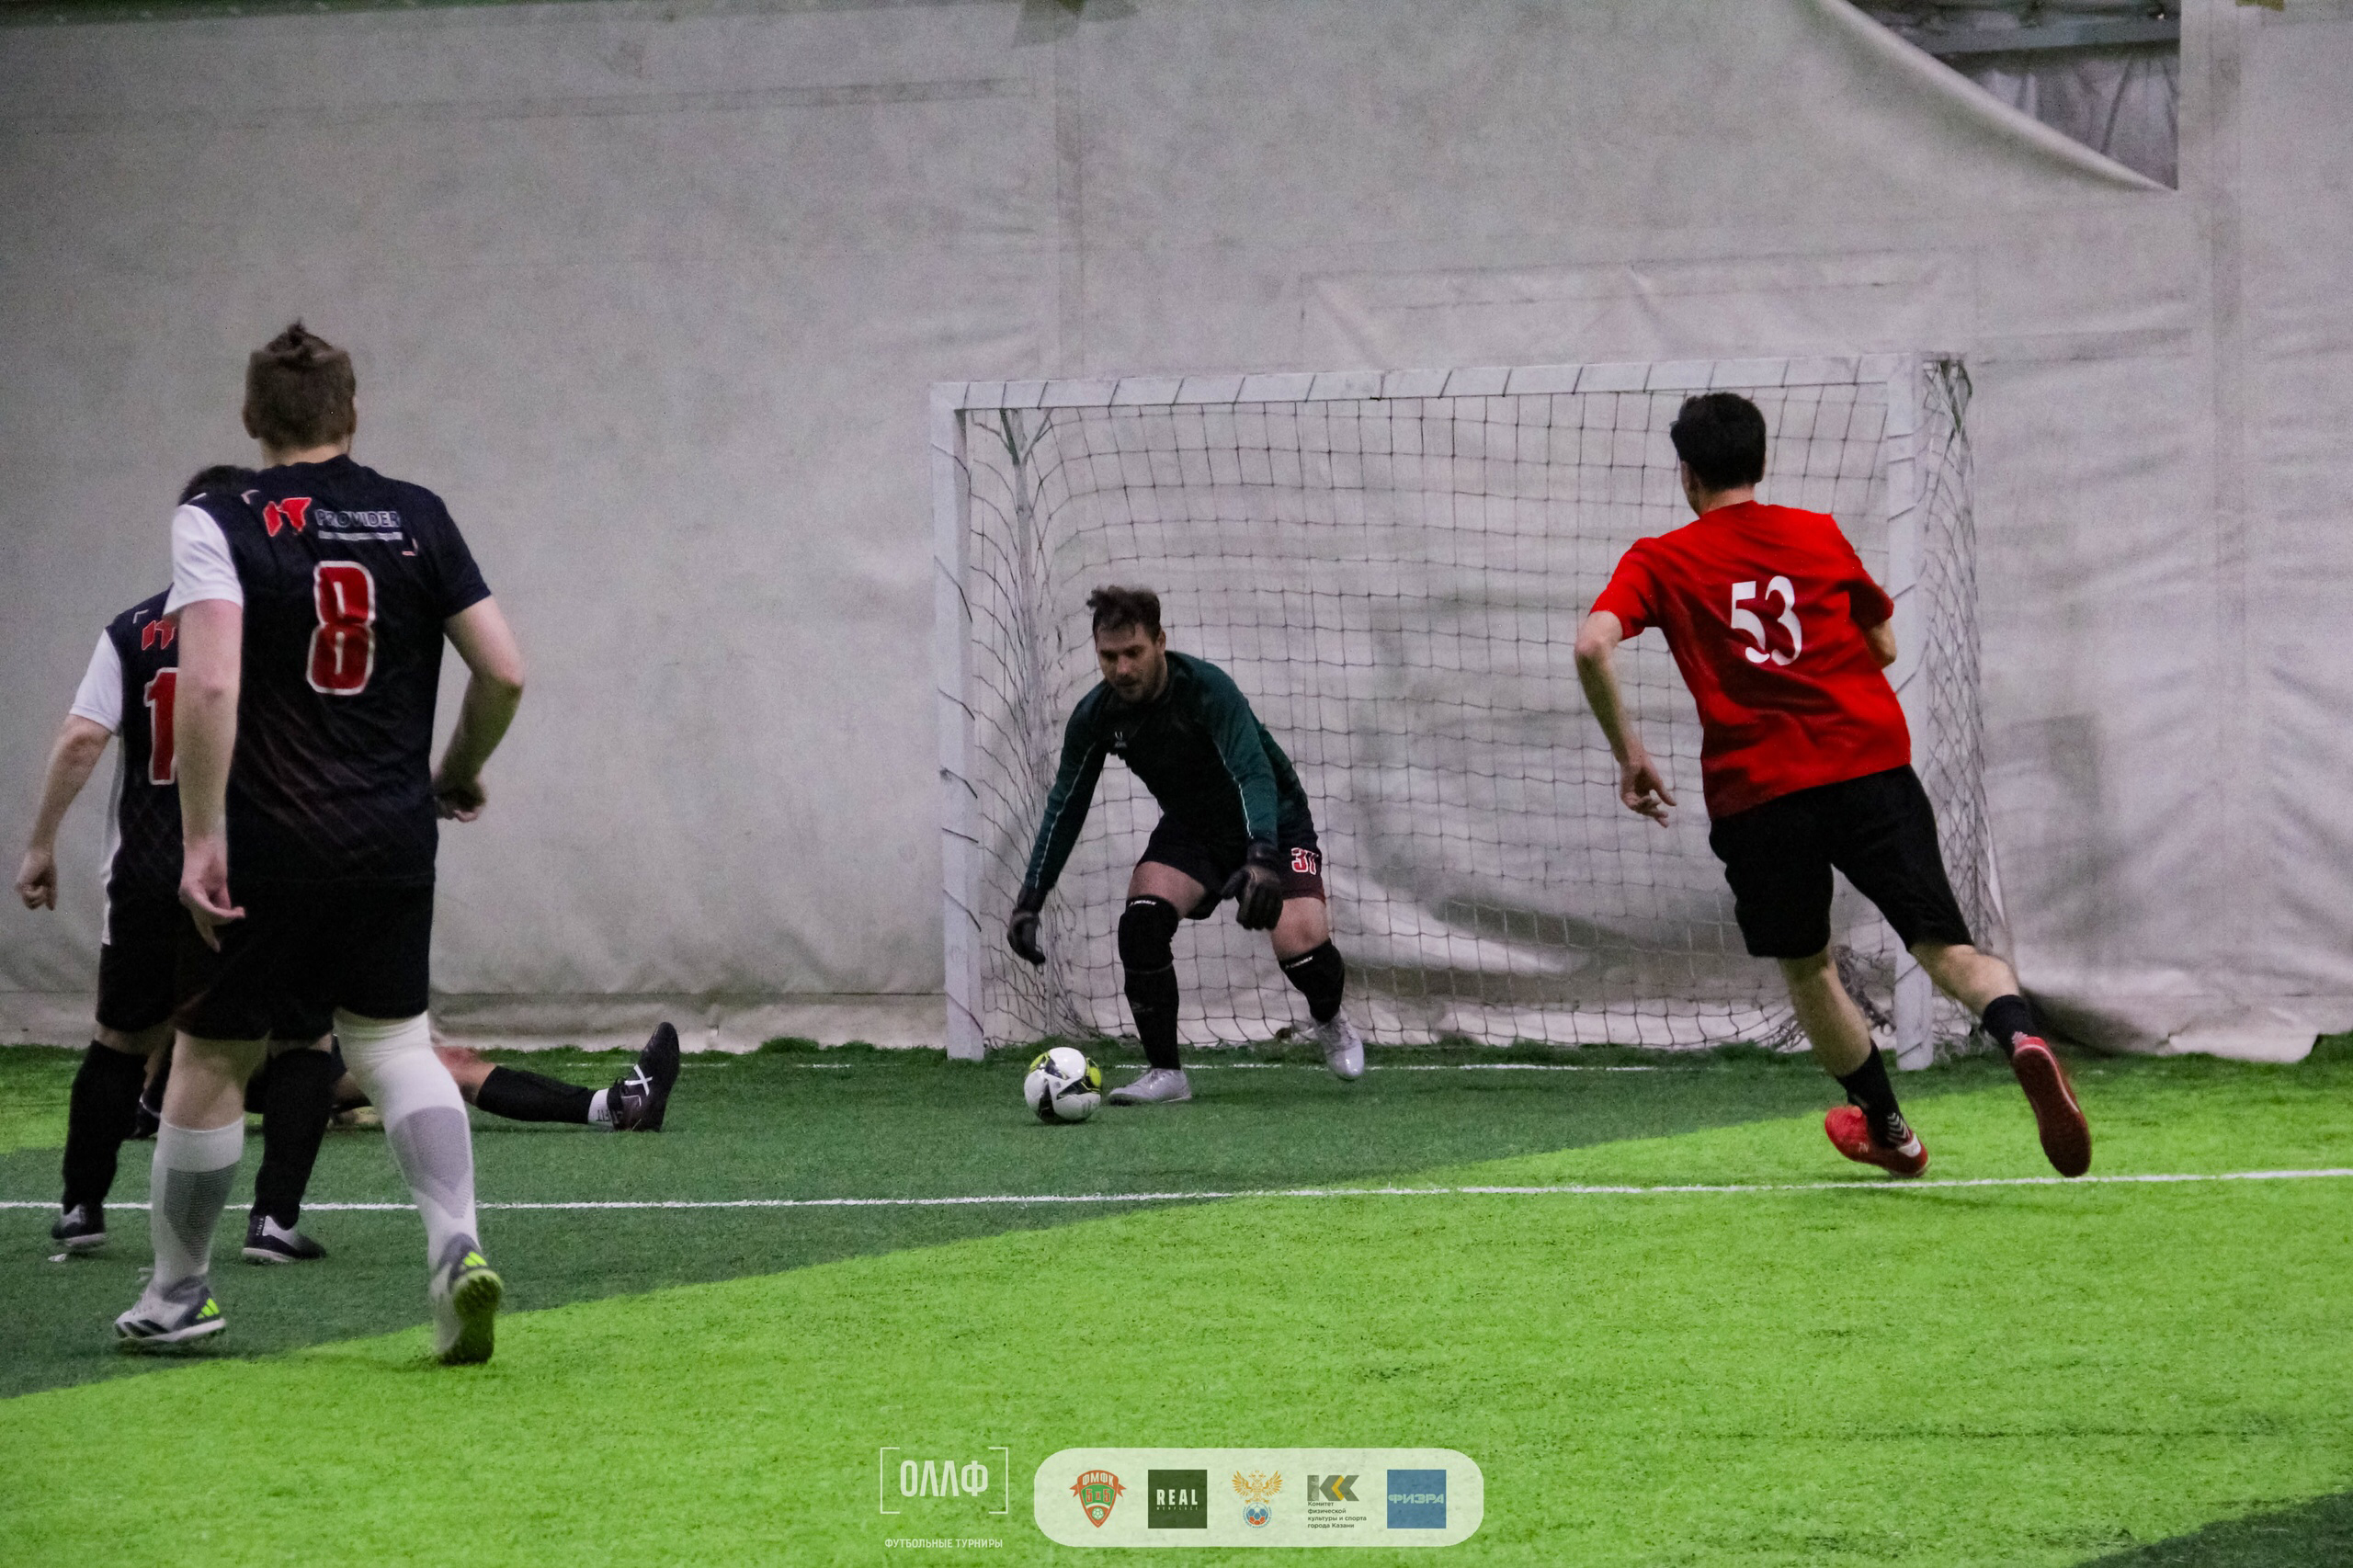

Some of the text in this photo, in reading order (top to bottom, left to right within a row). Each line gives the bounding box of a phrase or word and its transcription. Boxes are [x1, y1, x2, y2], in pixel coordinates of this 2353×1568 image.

[314, 508, 401, 529] PROVIDER
[306, 560, 376, 695] 8
[1731, 575, 1802, 665] 53
